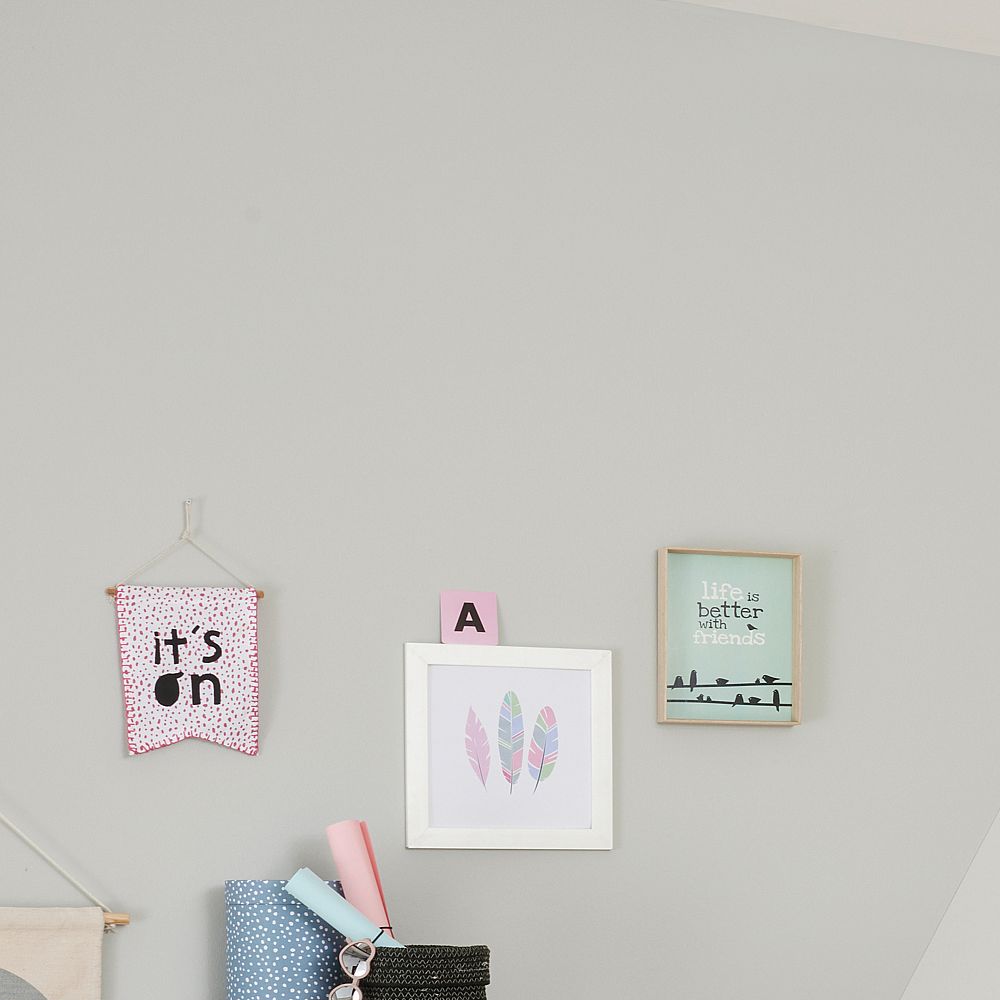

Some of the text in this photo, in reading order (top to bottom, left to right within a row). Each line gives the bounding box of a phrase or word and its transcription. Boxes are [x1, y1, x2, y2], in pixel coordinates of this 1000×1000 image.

[701, 580, 760, 602] life is
[454, 602, 486, 633] A
[697, 600, 764, 619] better
[698, 618, 727, 630] with
[153, 624, 223, 665] it's
[692, 628, 766, 646] friends
[154, 671, 222, 707] on
